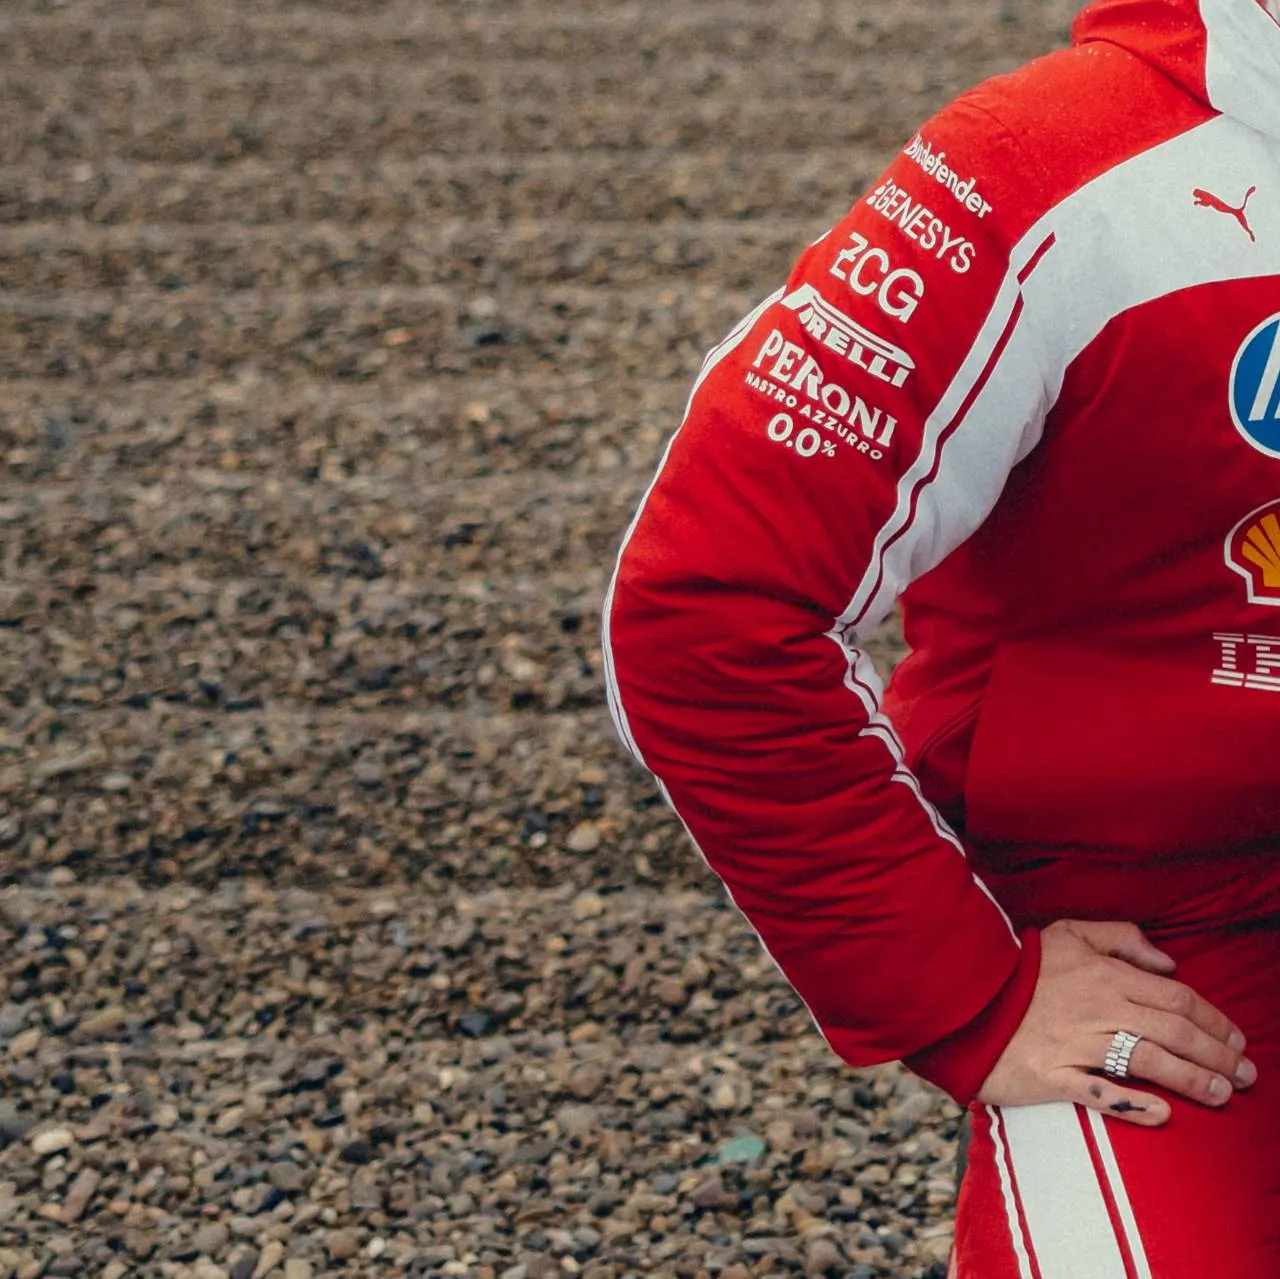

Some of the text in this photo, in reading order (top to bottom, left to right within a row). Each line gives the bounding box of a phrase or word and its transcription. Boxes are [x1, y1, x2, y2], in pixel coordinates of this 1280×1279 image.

[874, 184, 976, 274] GENESYS
[780, 282, 916, 388] PIRELLI
[745, 371, 884, 461] NASTRO AZZURRO
[752, 328, 898, 448] PERONI
[767, 412, 838, 458] 0.0%
